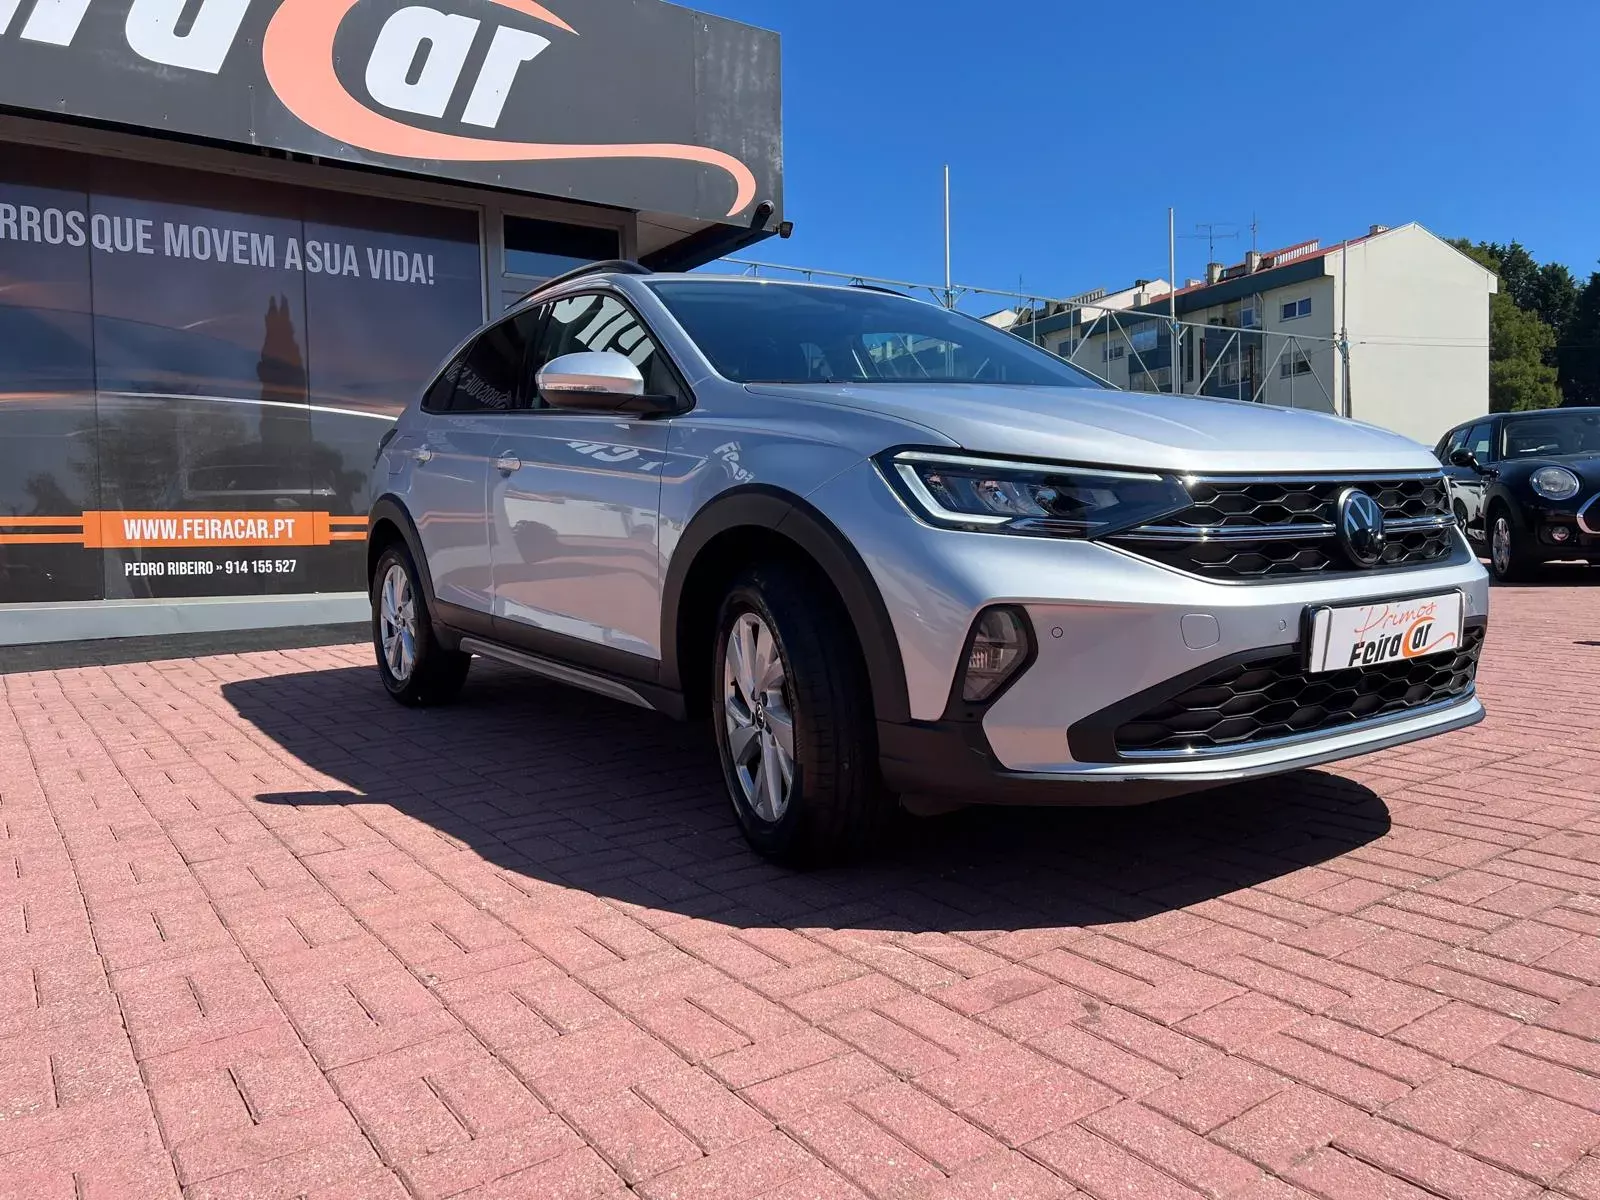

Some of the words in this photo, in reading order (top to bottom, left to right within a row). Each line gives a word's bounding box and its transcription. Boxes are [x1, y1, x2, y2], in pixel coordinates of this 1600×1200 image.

[0, 202, 86, 247] RROS
[91, 213, 154, 254] QUE
[163, 222, 275, 268] MOVEM
[284, 237, 303, 271] A
[304, 240, 360, 277] SUA
[366, 247, 434, 285] VIDA!
[123, 518, 295, 540] WWW.FEIRACAR.PT
[125, 562, 165, 577] PEDRO
[168, 561, 214, 576] RIBEIRO
[225, 560, 249, 574] 914
[251, 560, 273, 573] 155
[275, 559, 297, 573] 527
